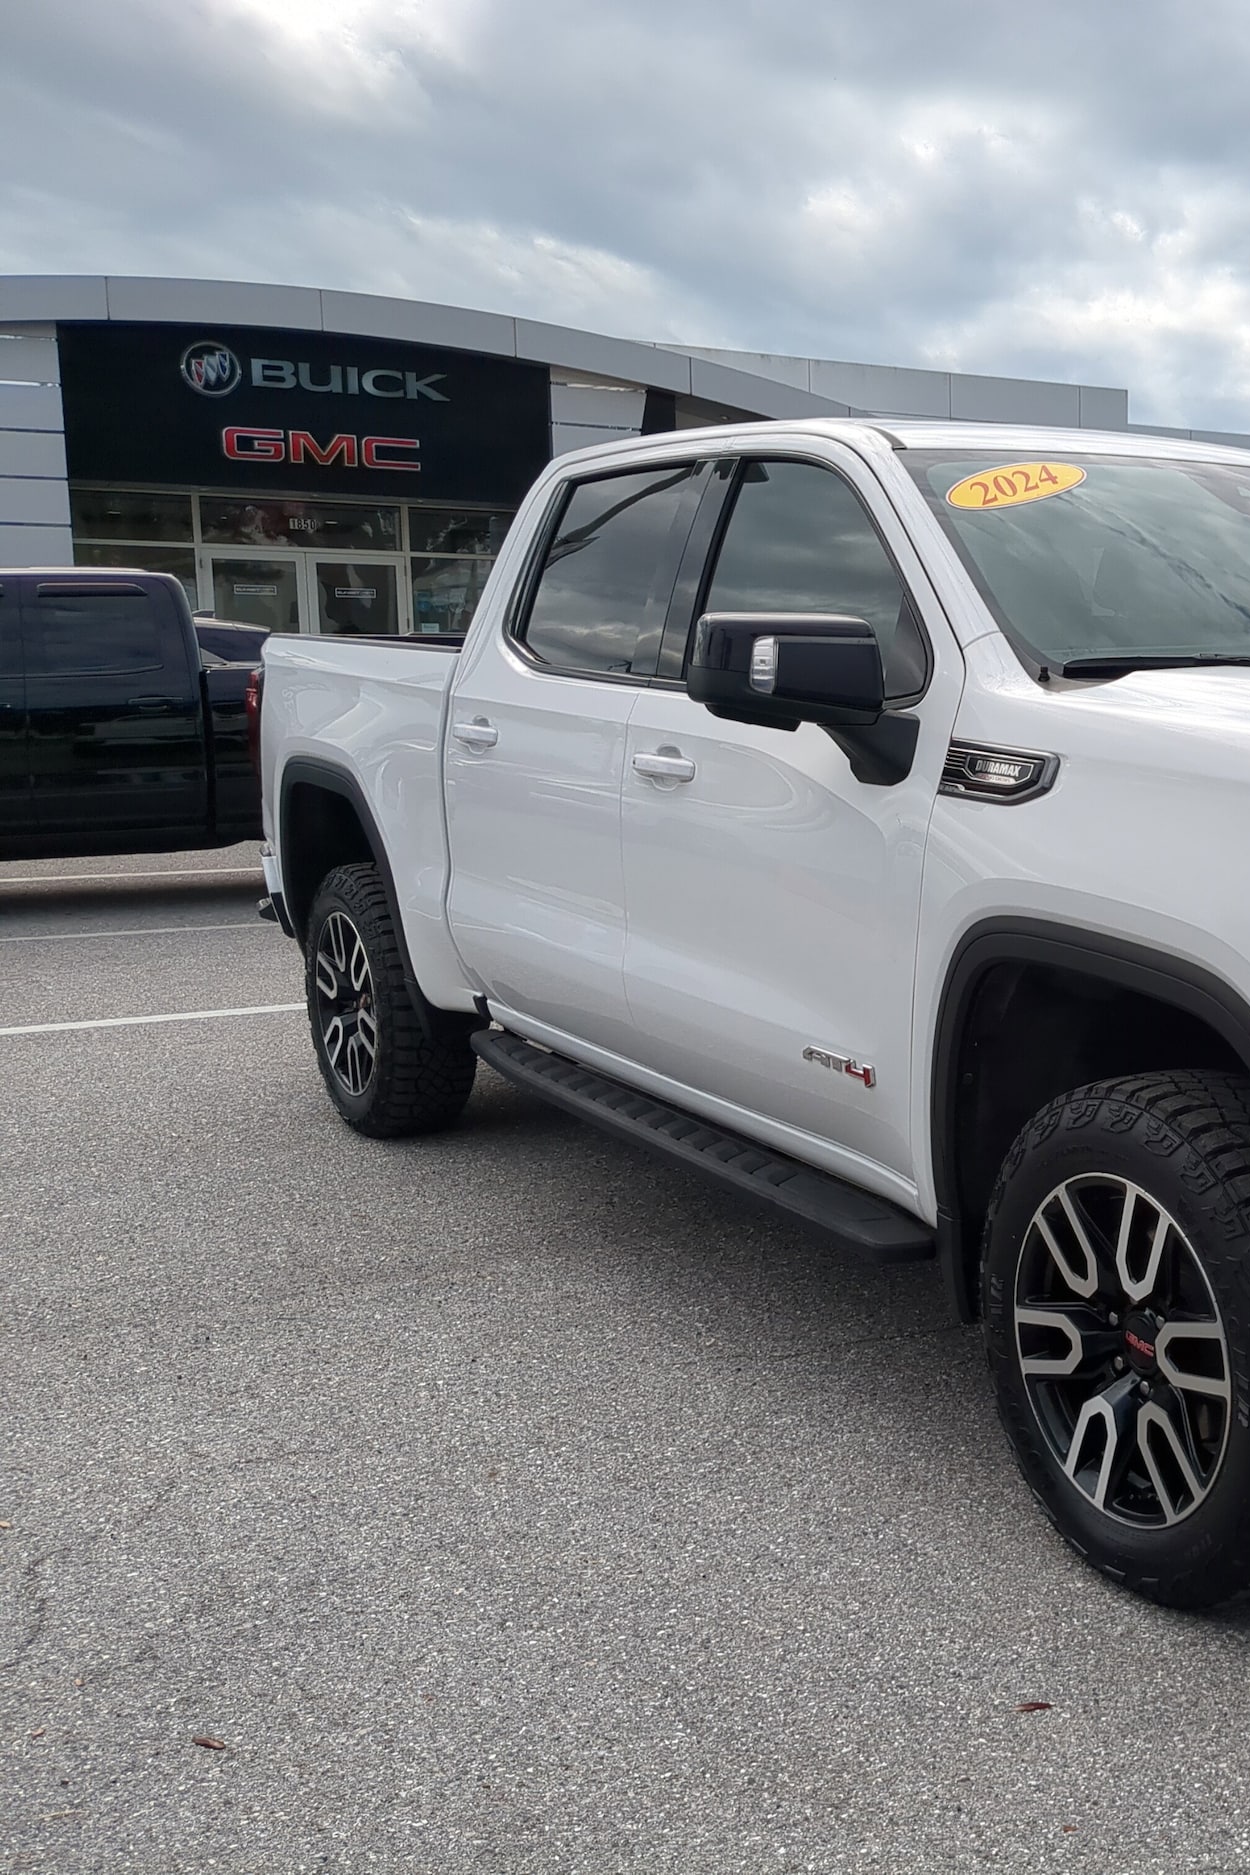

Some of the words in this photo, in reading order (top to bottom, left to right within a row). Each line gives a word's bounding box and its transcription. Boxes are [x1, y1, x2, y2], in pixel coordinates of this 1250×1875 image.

[250, 358, 450, 401] BUICK
[222, 426, 421, 471] GMC
[970, 464, 1059, 506] 2024
[974, 759, 1022, 778] DURAMAX
[802, 1045, 876, 1088] AT4
[1125, 1330, 1155, 1357] GMC
